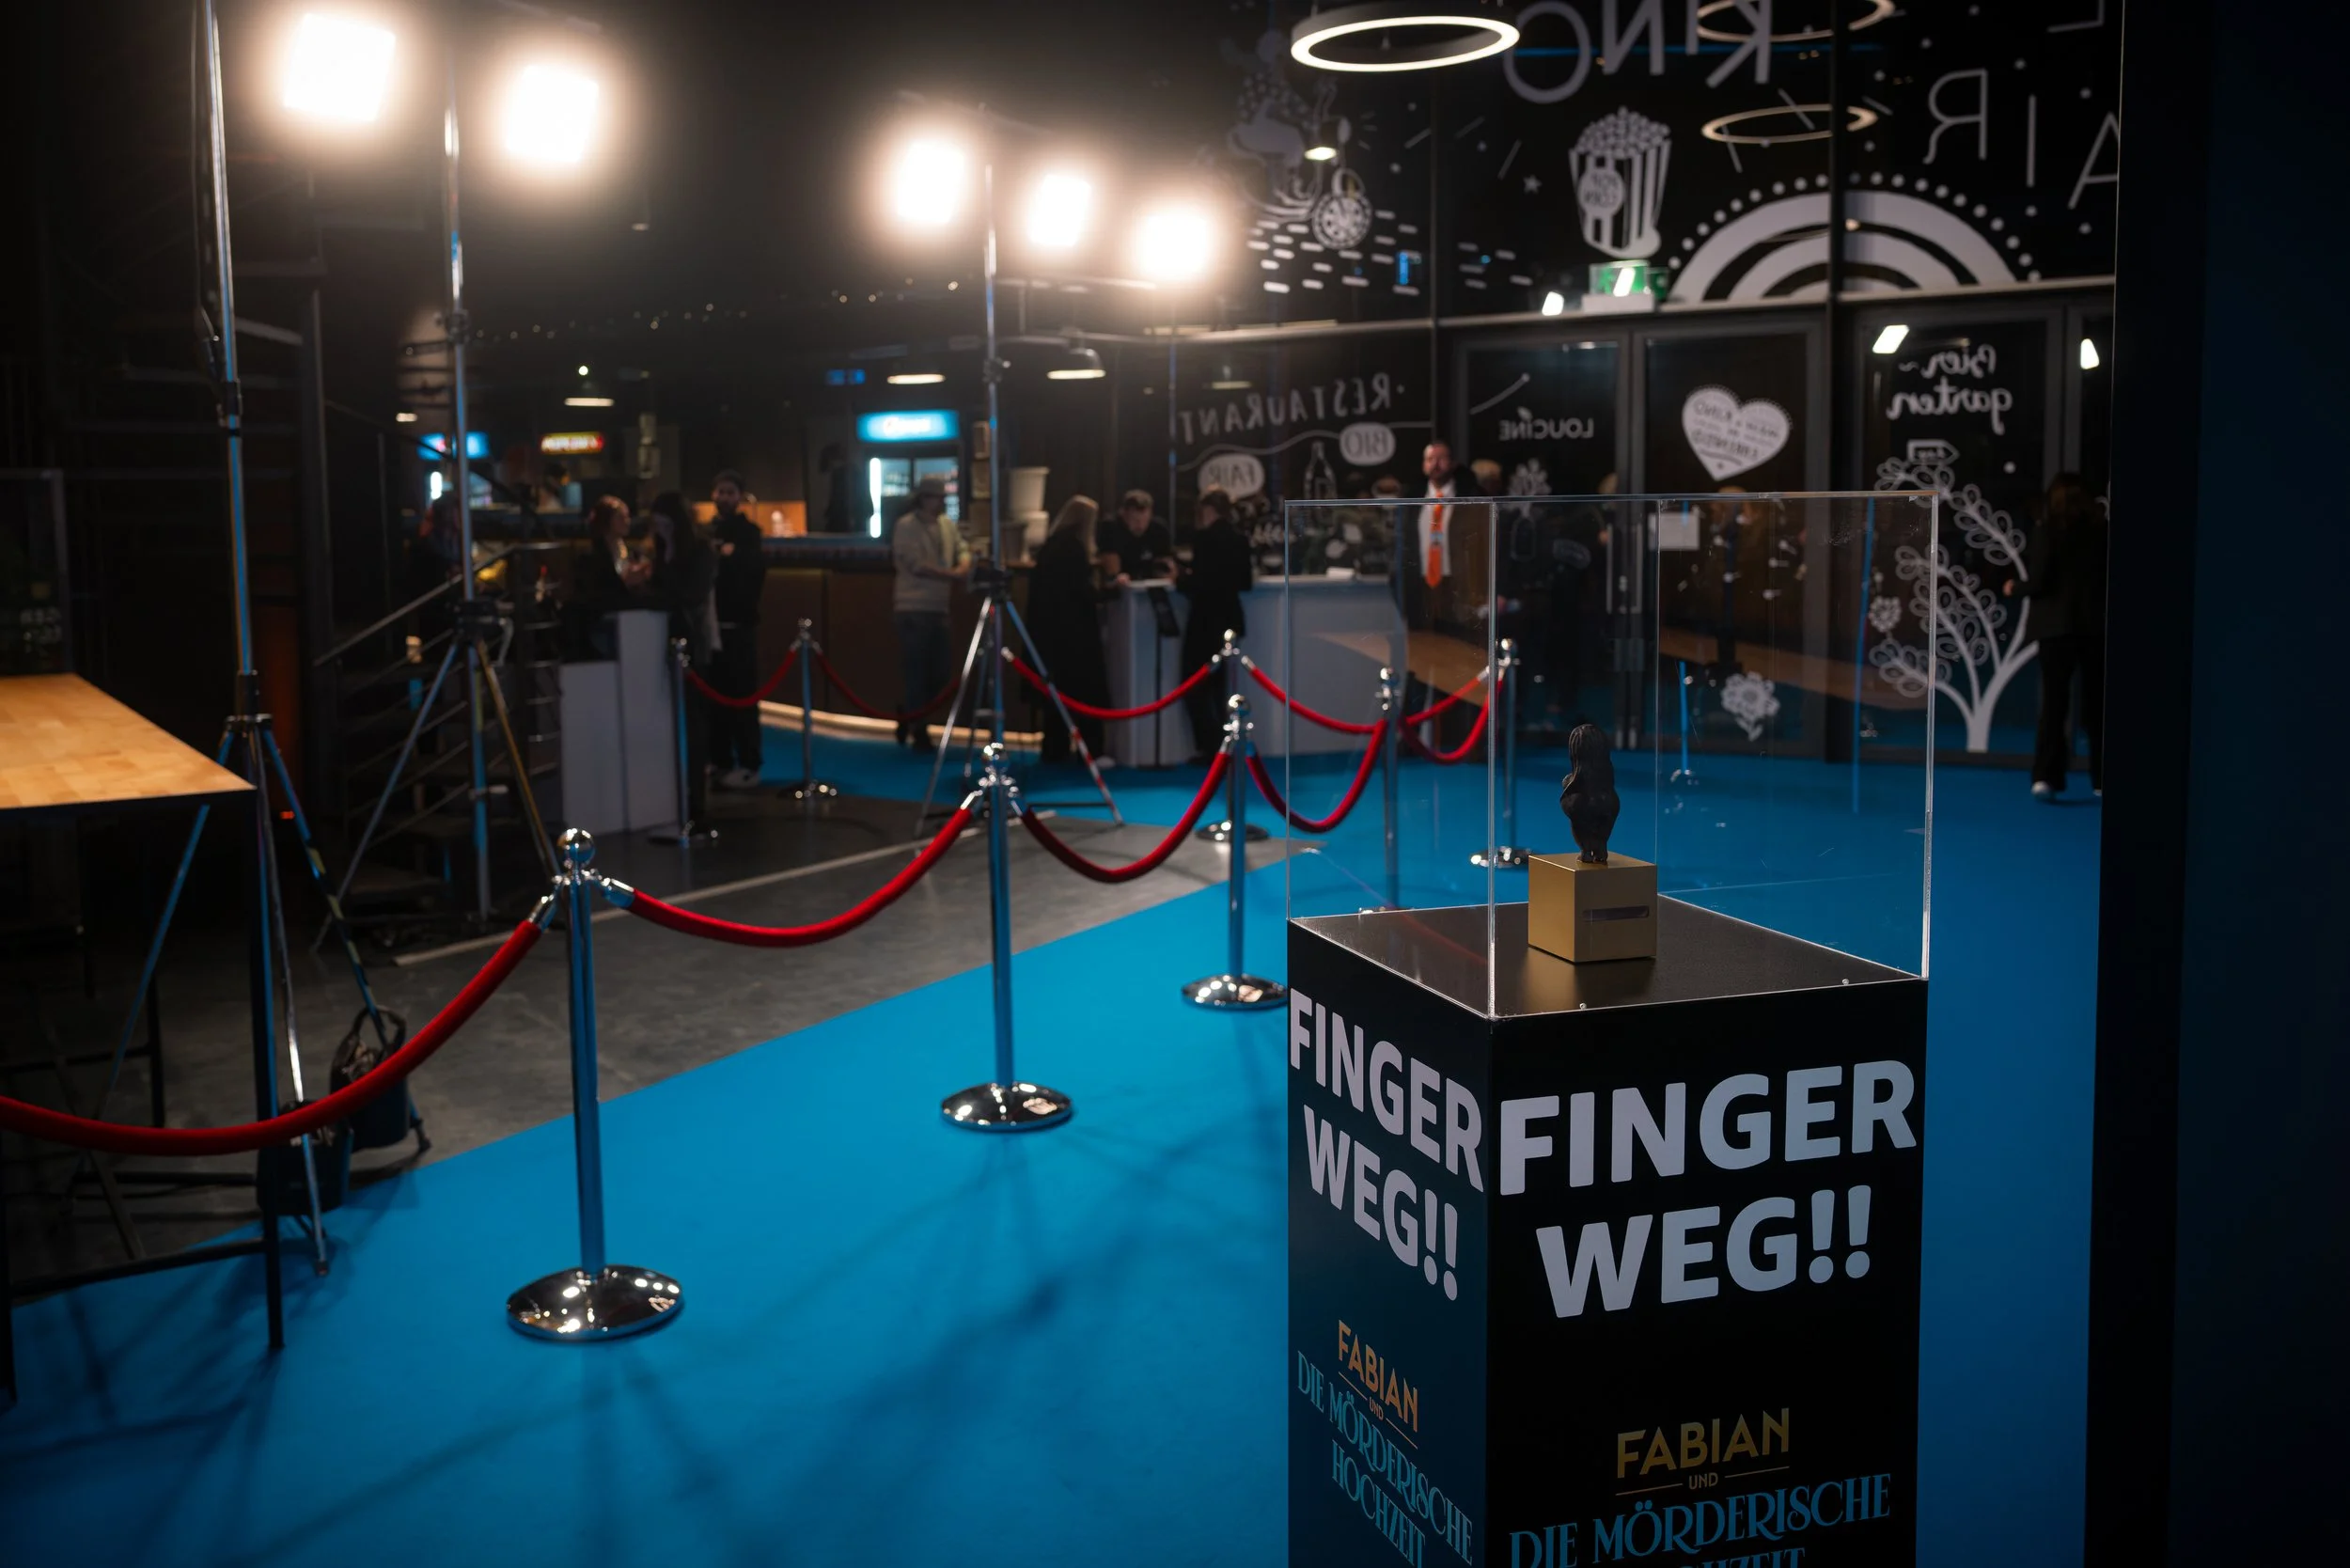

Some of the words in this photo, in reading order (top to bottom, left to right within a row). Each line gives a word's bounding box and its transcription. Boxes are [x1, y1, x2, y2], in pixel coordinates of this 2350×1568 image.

[1290, 987, 1483, 1193] FINGER
[1500, 1059, 1917, 1196] FINGER
[1304, 1104, 1459, 1302] WEG!!
[1536, 1184, 1872, 1319] WEG!!
[1339, 1319, 1418, 1433] FABIAN
[1369, 1396, 1384, 1420] UND
[1616, 1407, 1790, 1460] FABIAN
[1297, 1350, 1324, 1414] DIE
[1328, 1381, 1473, 1566] MÖRDERISCHE
[1331, 1439, 1426, 1568] HOCHZEIT
[1509, 1522, 1578, 1568] DIE
[1592, 1472, 1891, 1564] MÖRDERISCHE
[1688, 1471, 1719, 1491] UND
